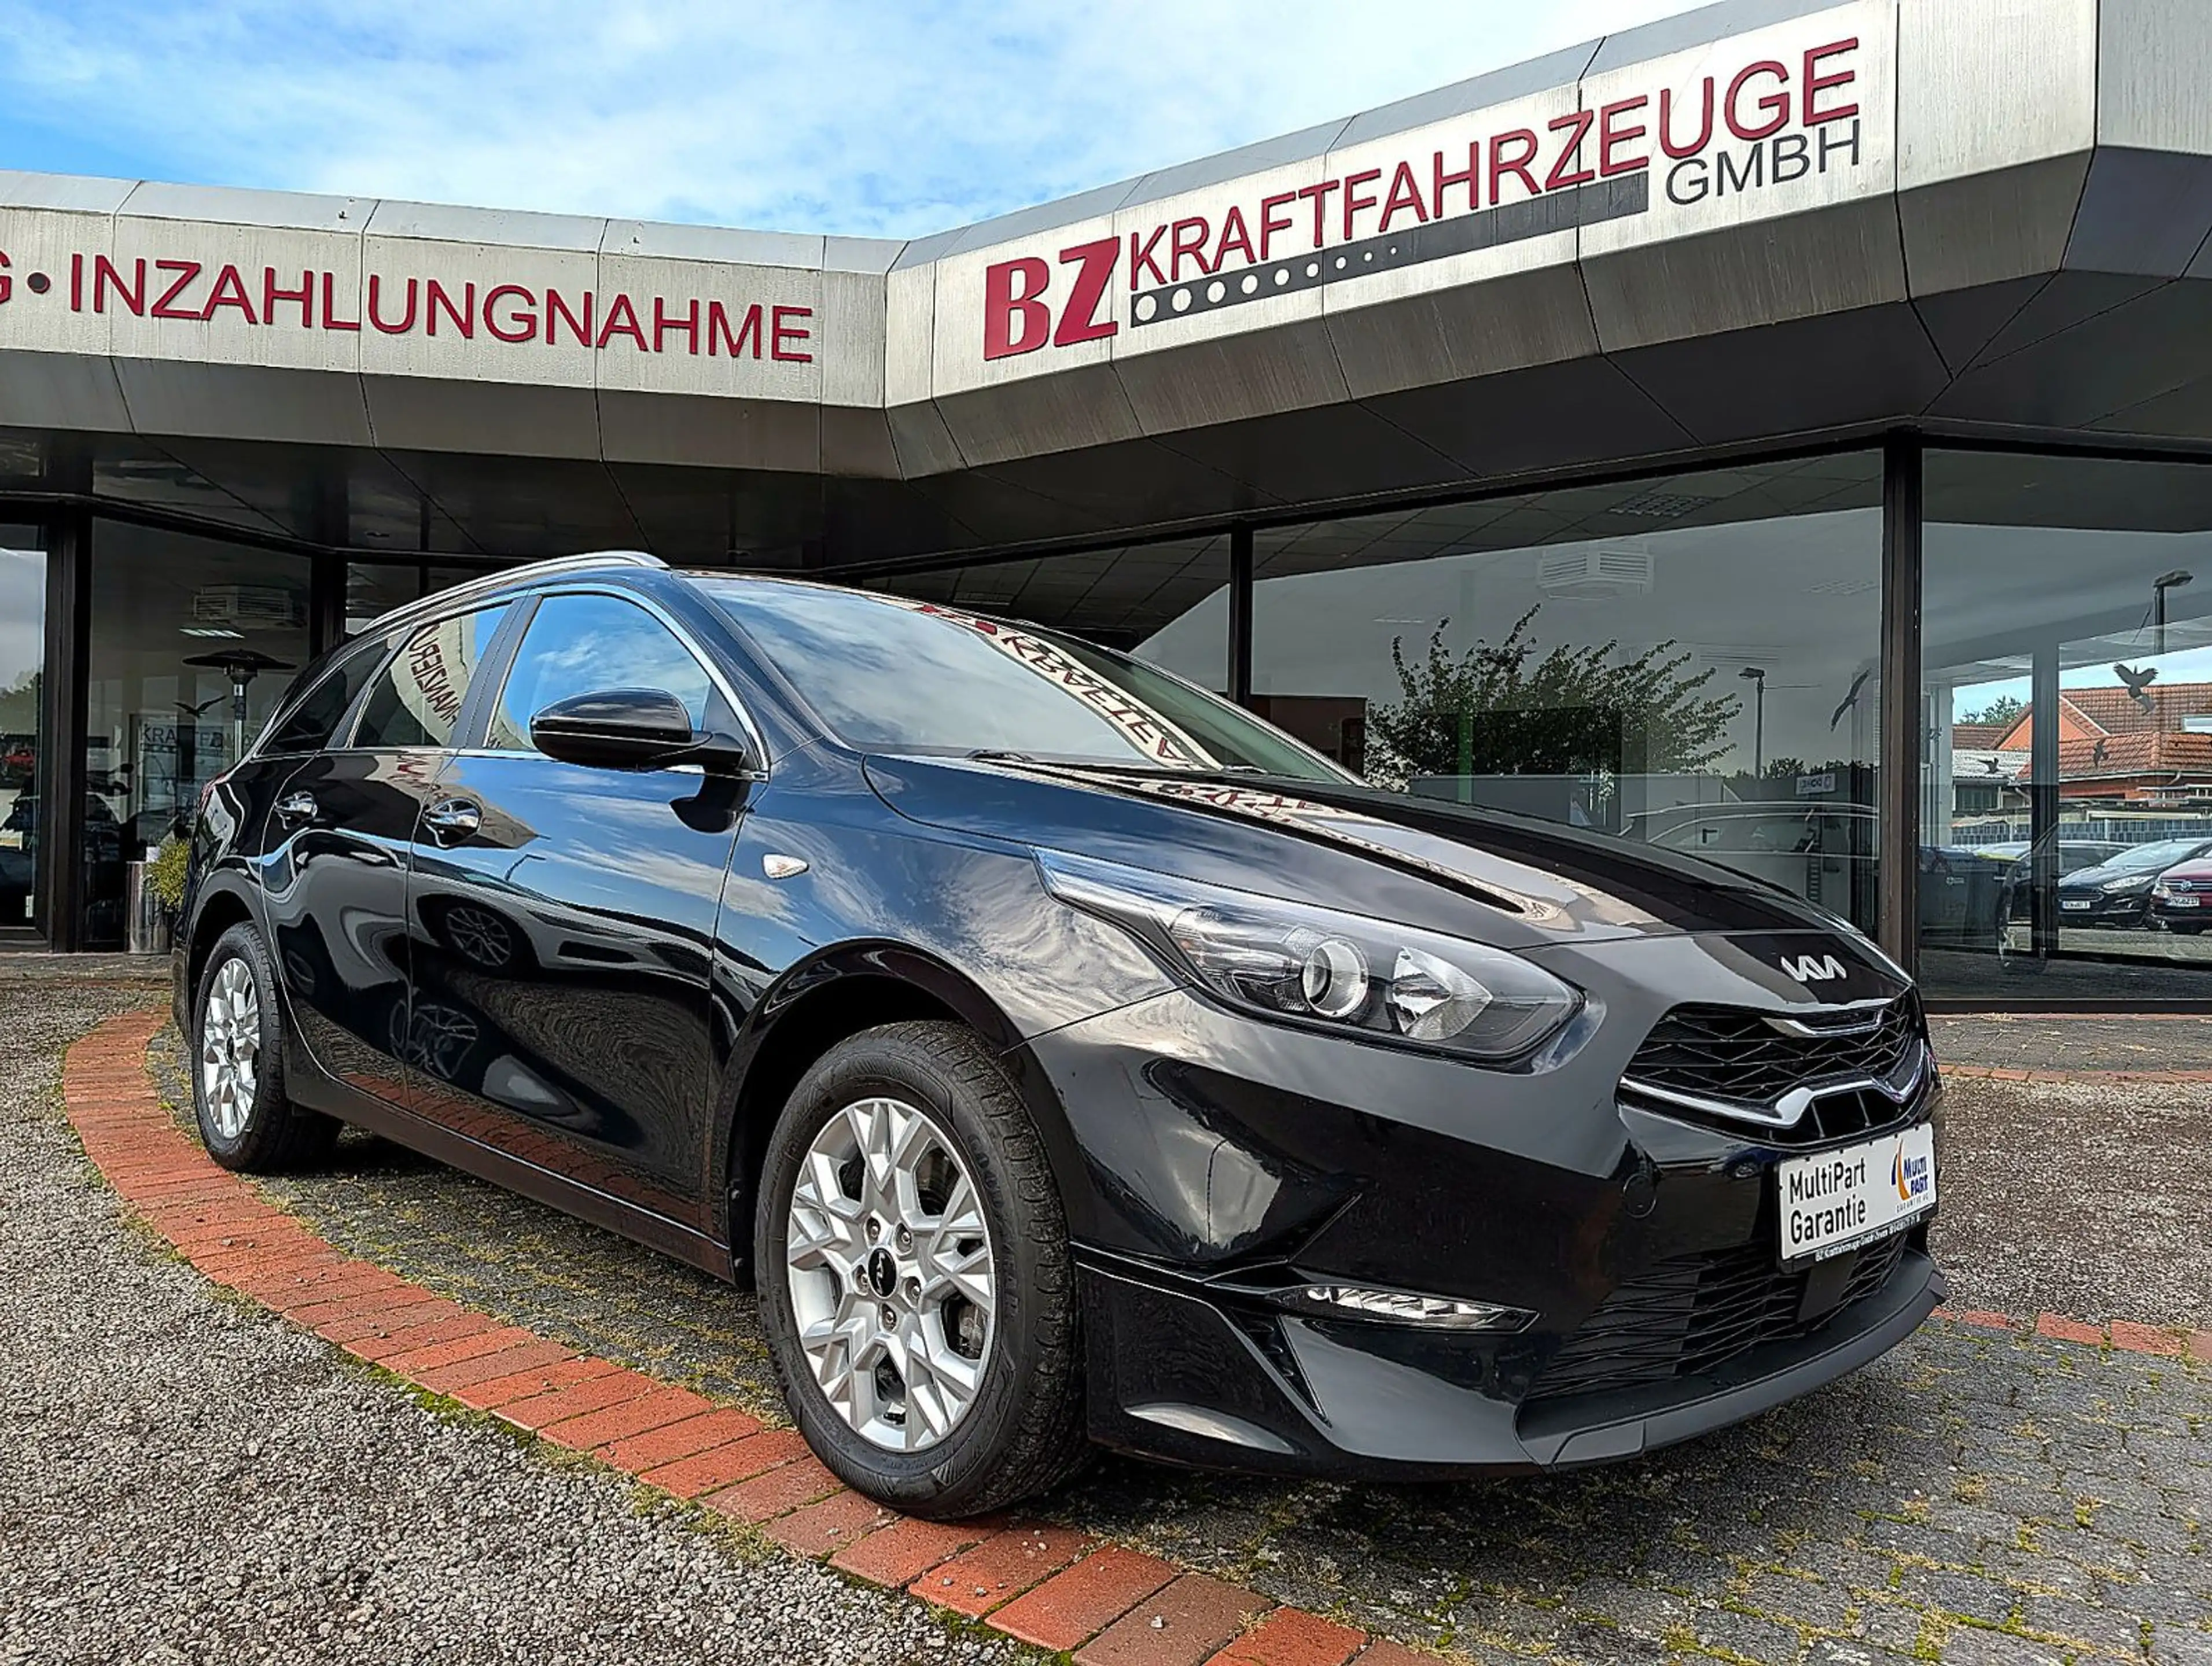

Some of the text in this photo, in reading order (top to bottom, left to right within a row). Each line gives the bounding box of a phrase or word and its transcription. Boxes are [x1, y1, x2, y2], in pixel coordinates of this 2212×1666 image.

[1666, 119, 1860, 205] GMBH
[984, 38, 1858, 360] BZ KRAFTFAHRZEUGE
[71, 253, 813, 363] INZAHLUNGNAHME
[1780, 955, 1846, 982] KIA
[1788, 1158, 1866, 1204] MultiPart
[1790, 1195, 1866, 1244] Garantie
